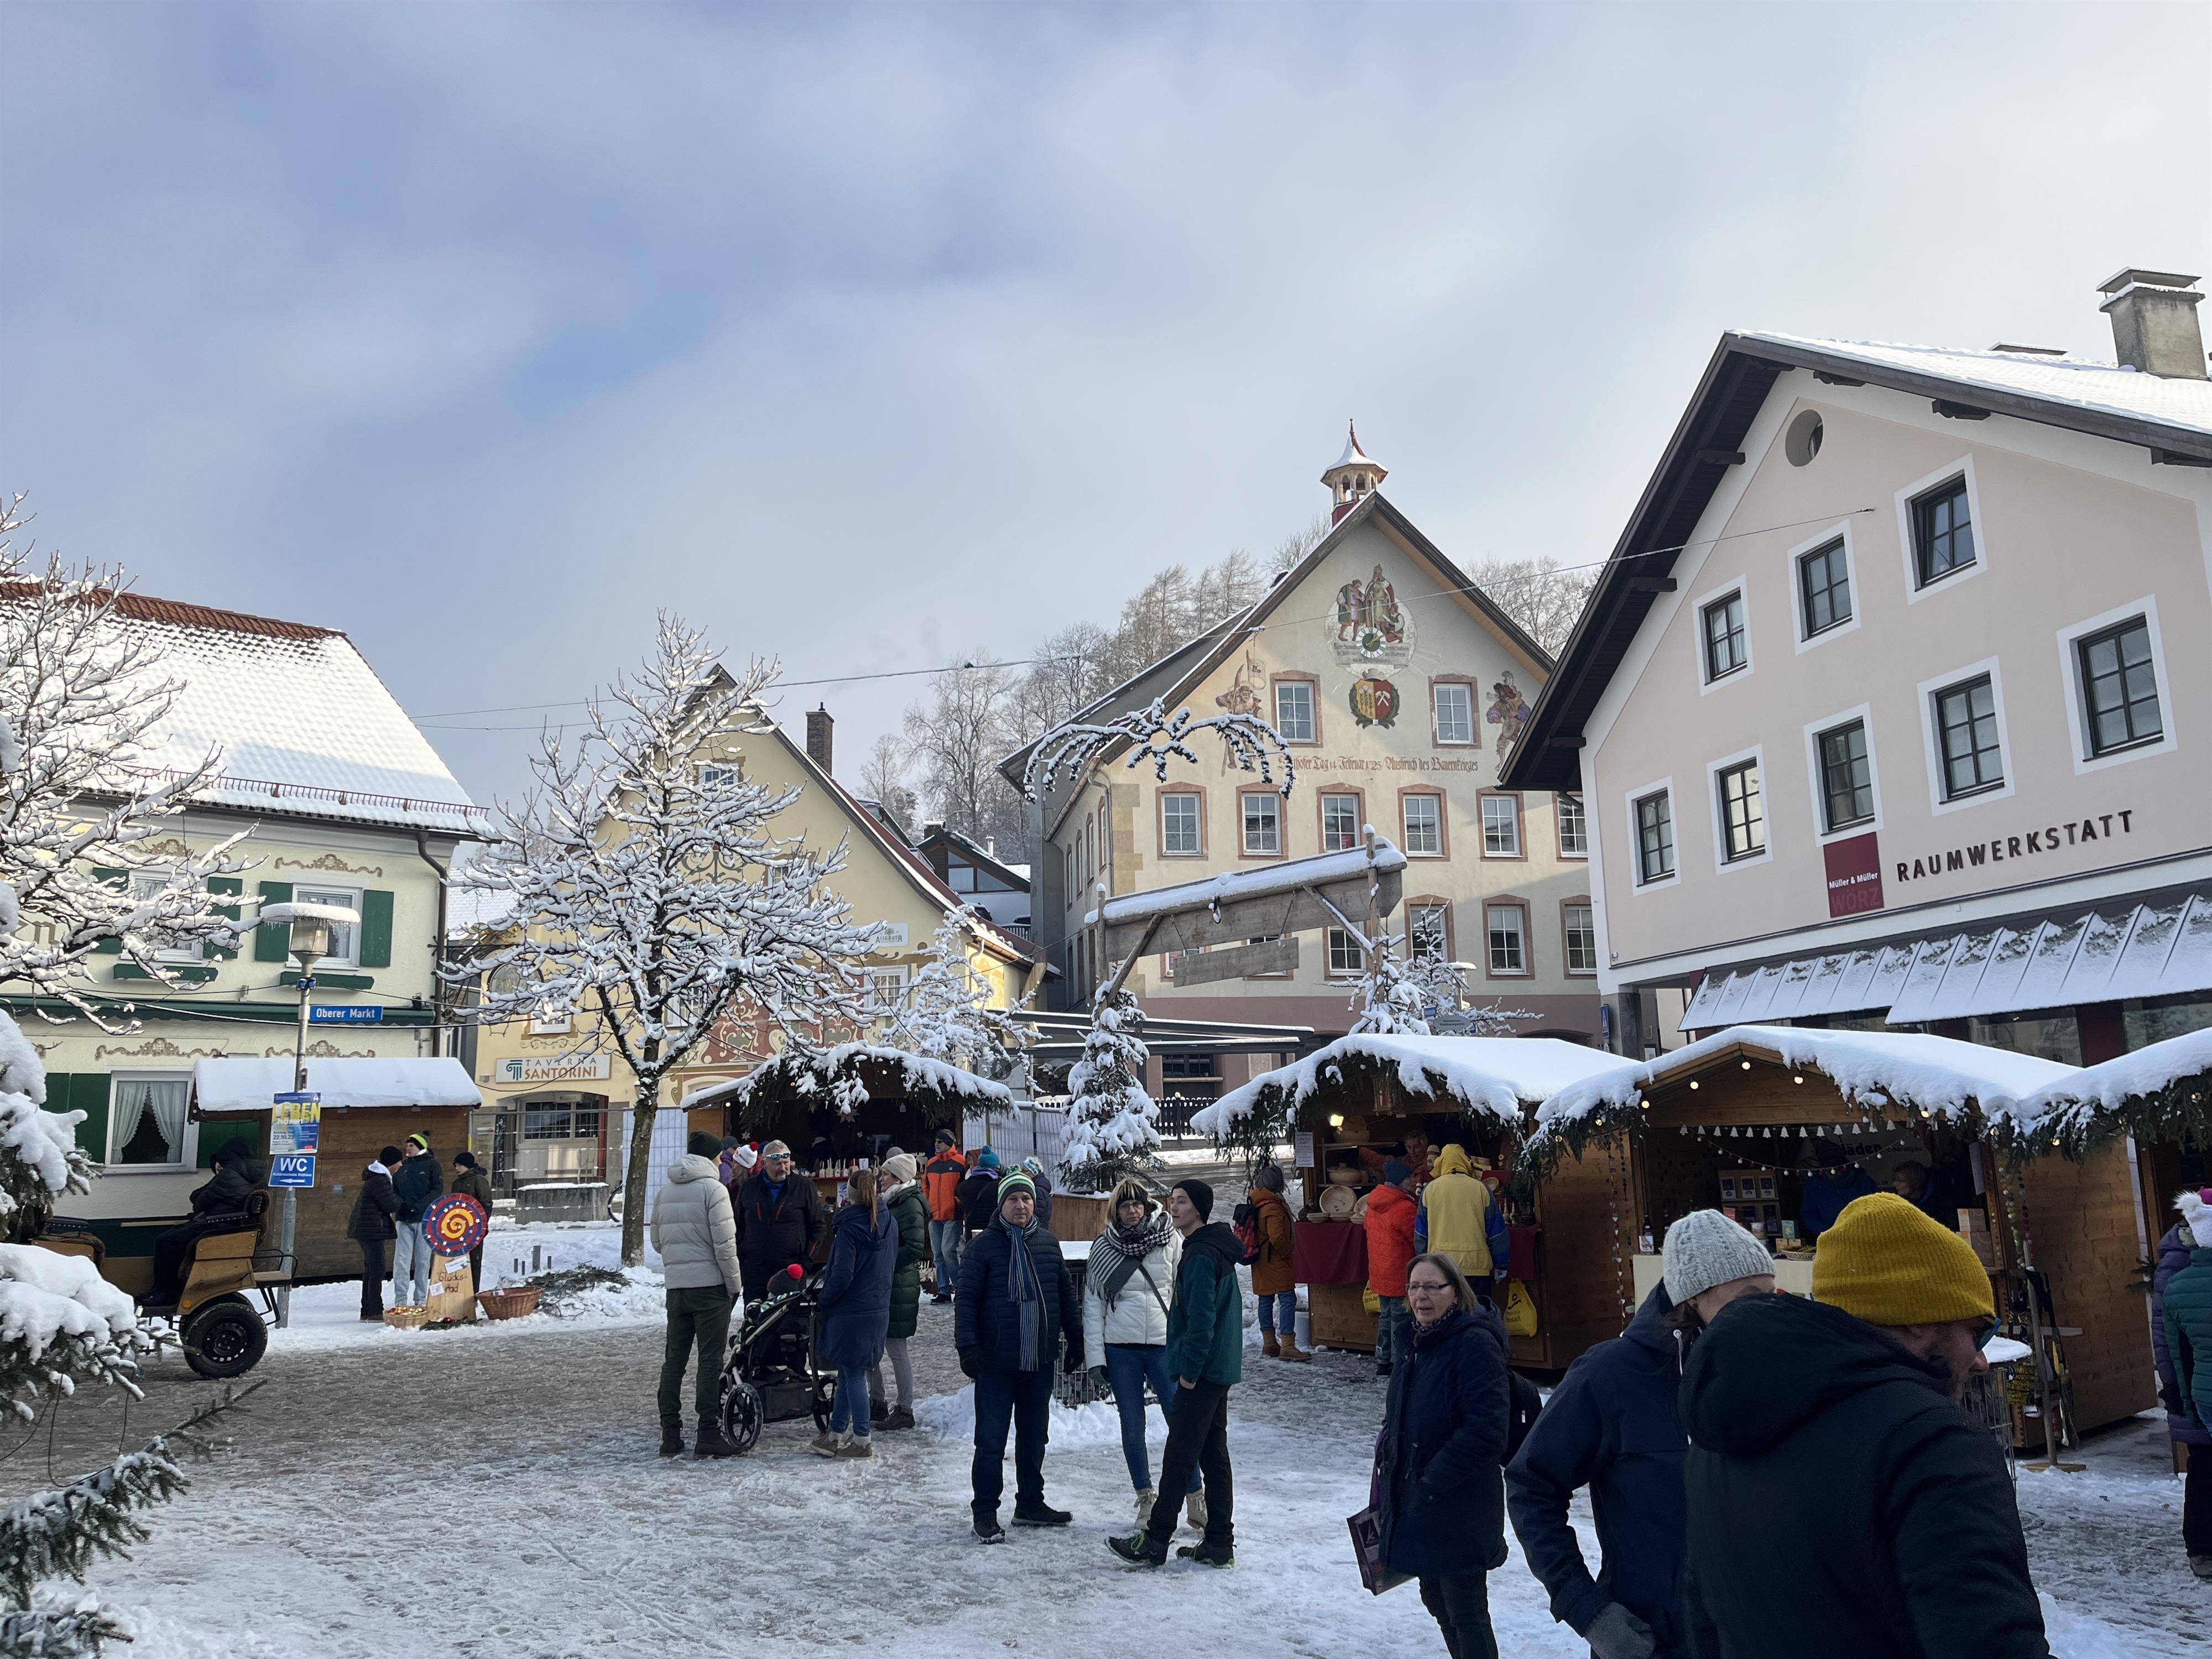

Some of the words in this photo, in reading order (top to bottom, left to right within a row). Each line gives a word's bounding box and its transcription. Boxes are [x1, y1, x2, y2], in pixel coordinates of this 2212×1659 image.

[1312, 756, 1328, 771] Tag
[1384, 757, 1417, 771] Ausbruch
[1418, 758, 1430, 771] des
[1897, 810, 2132, 881] RAUMWERKSTATT
[1829, 879, 1849, 889] Müller
[1857, 873, 1878, 883] Müller
[1831, 887, 1881, 913] WÖRZ
[316, 1008, 346, 1018] Oberer
[349, 1009, 375, 1018] Markt
[526, 1057, 596, 1066] TAVERNA
[525, 1066, 597, 1079] SANTORINI
[272, 1102, 321, 1123] LEBEN
[280, 1157, 307, 1172] WC
